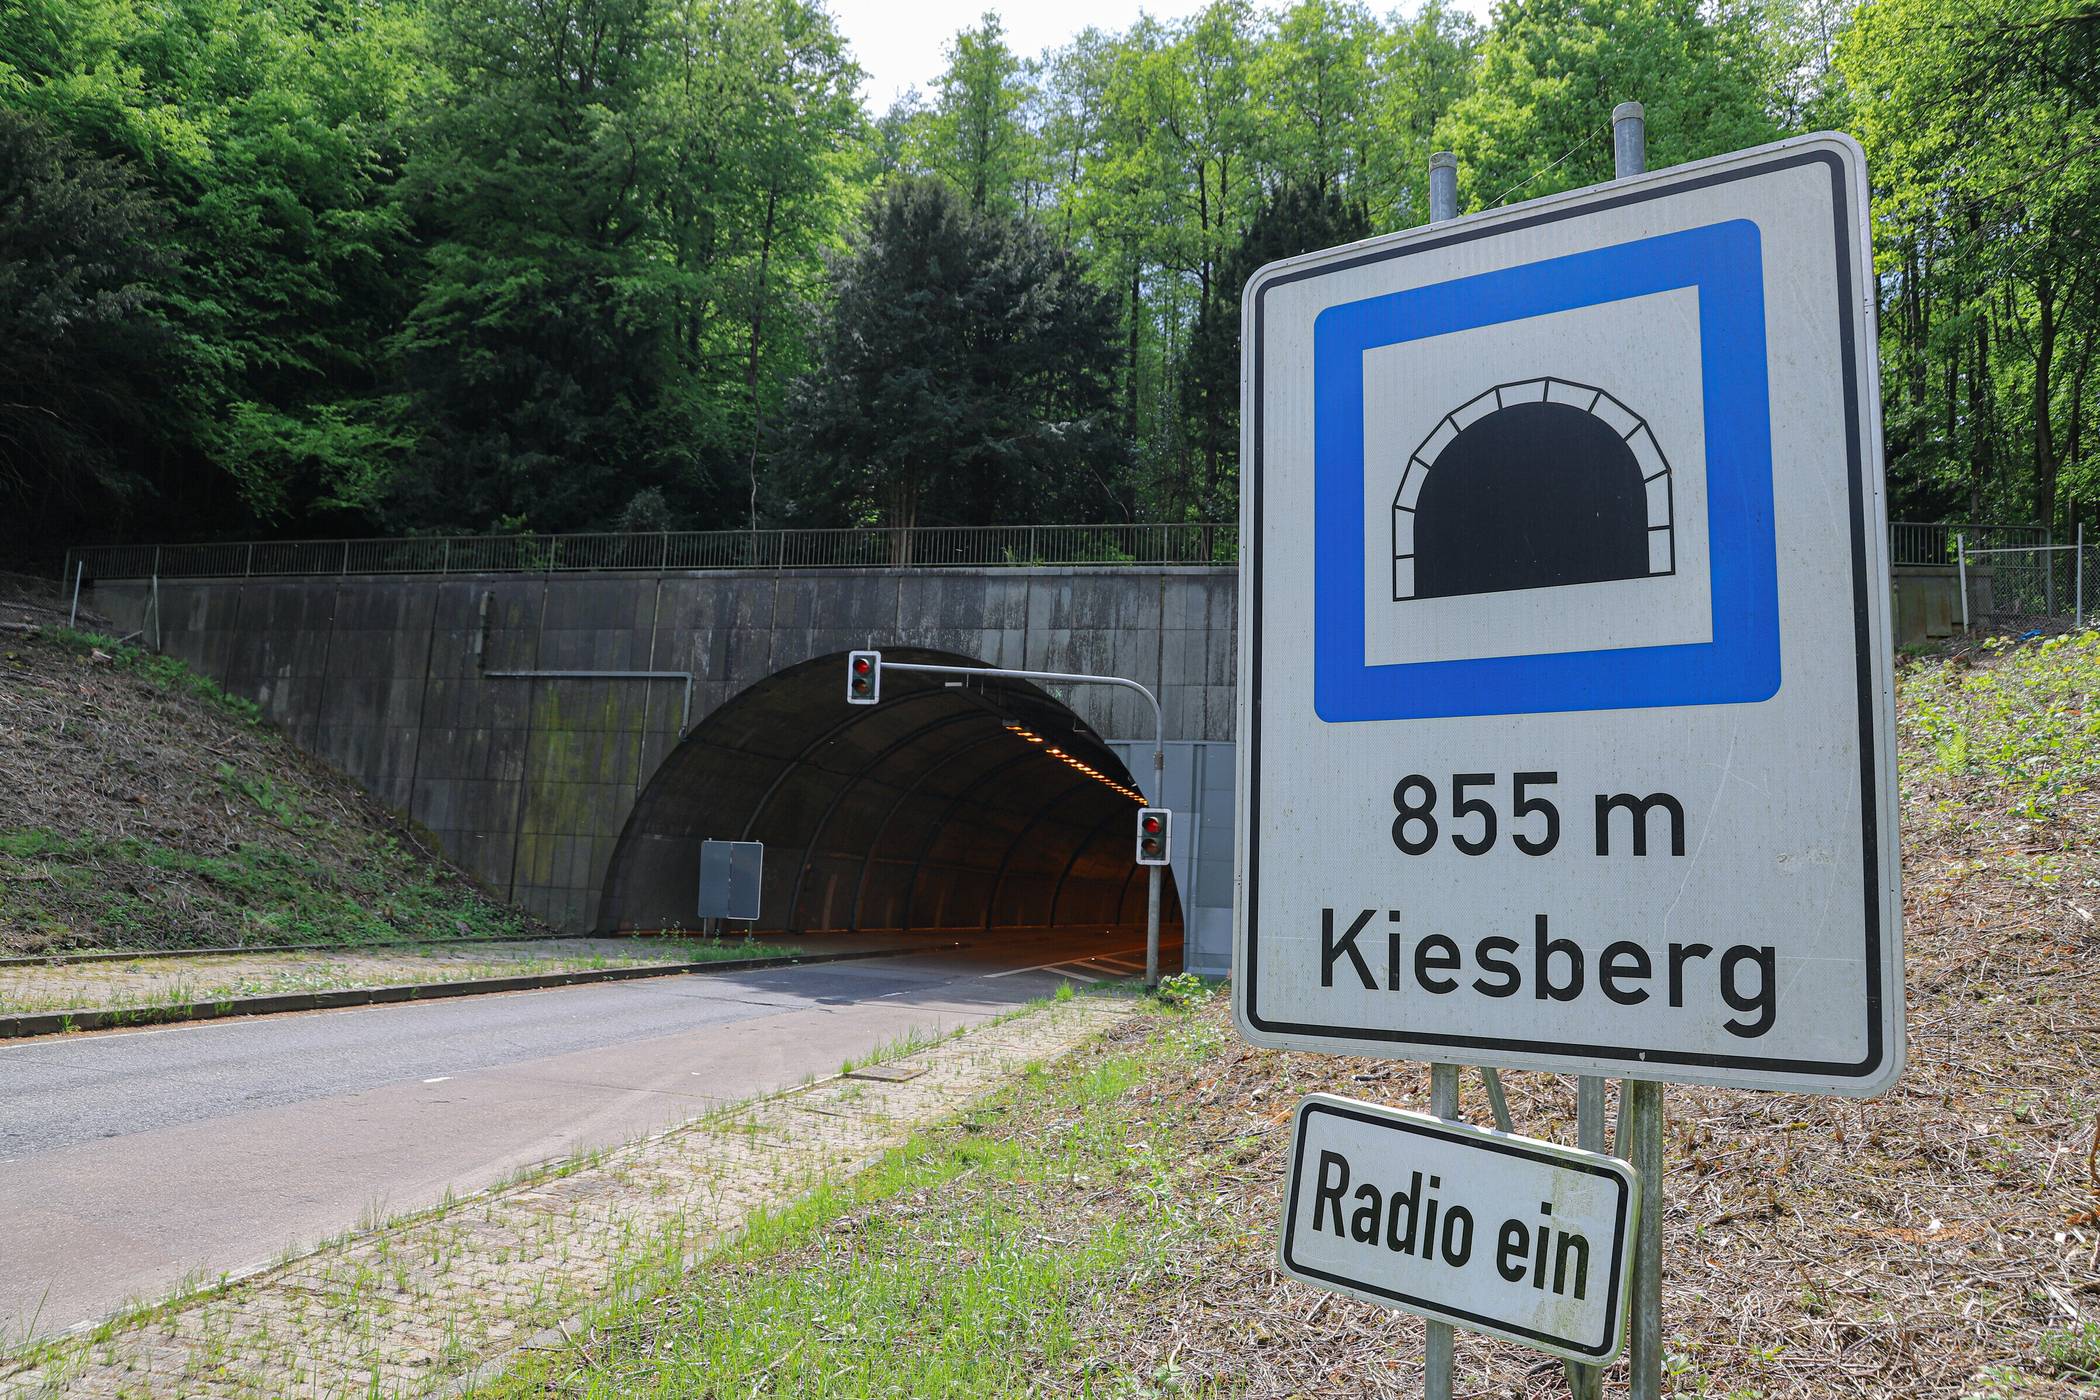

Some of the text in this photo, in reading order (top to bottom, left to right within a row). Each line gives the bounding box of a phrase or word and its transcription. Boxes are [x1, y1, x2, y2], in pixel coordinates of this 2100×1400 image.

[1391, 771, 1686, 857] 855 m
[1320, 908, 1777, 1039] Kiesberg
[1312, 1149, 1590, 1301] Radio ein
